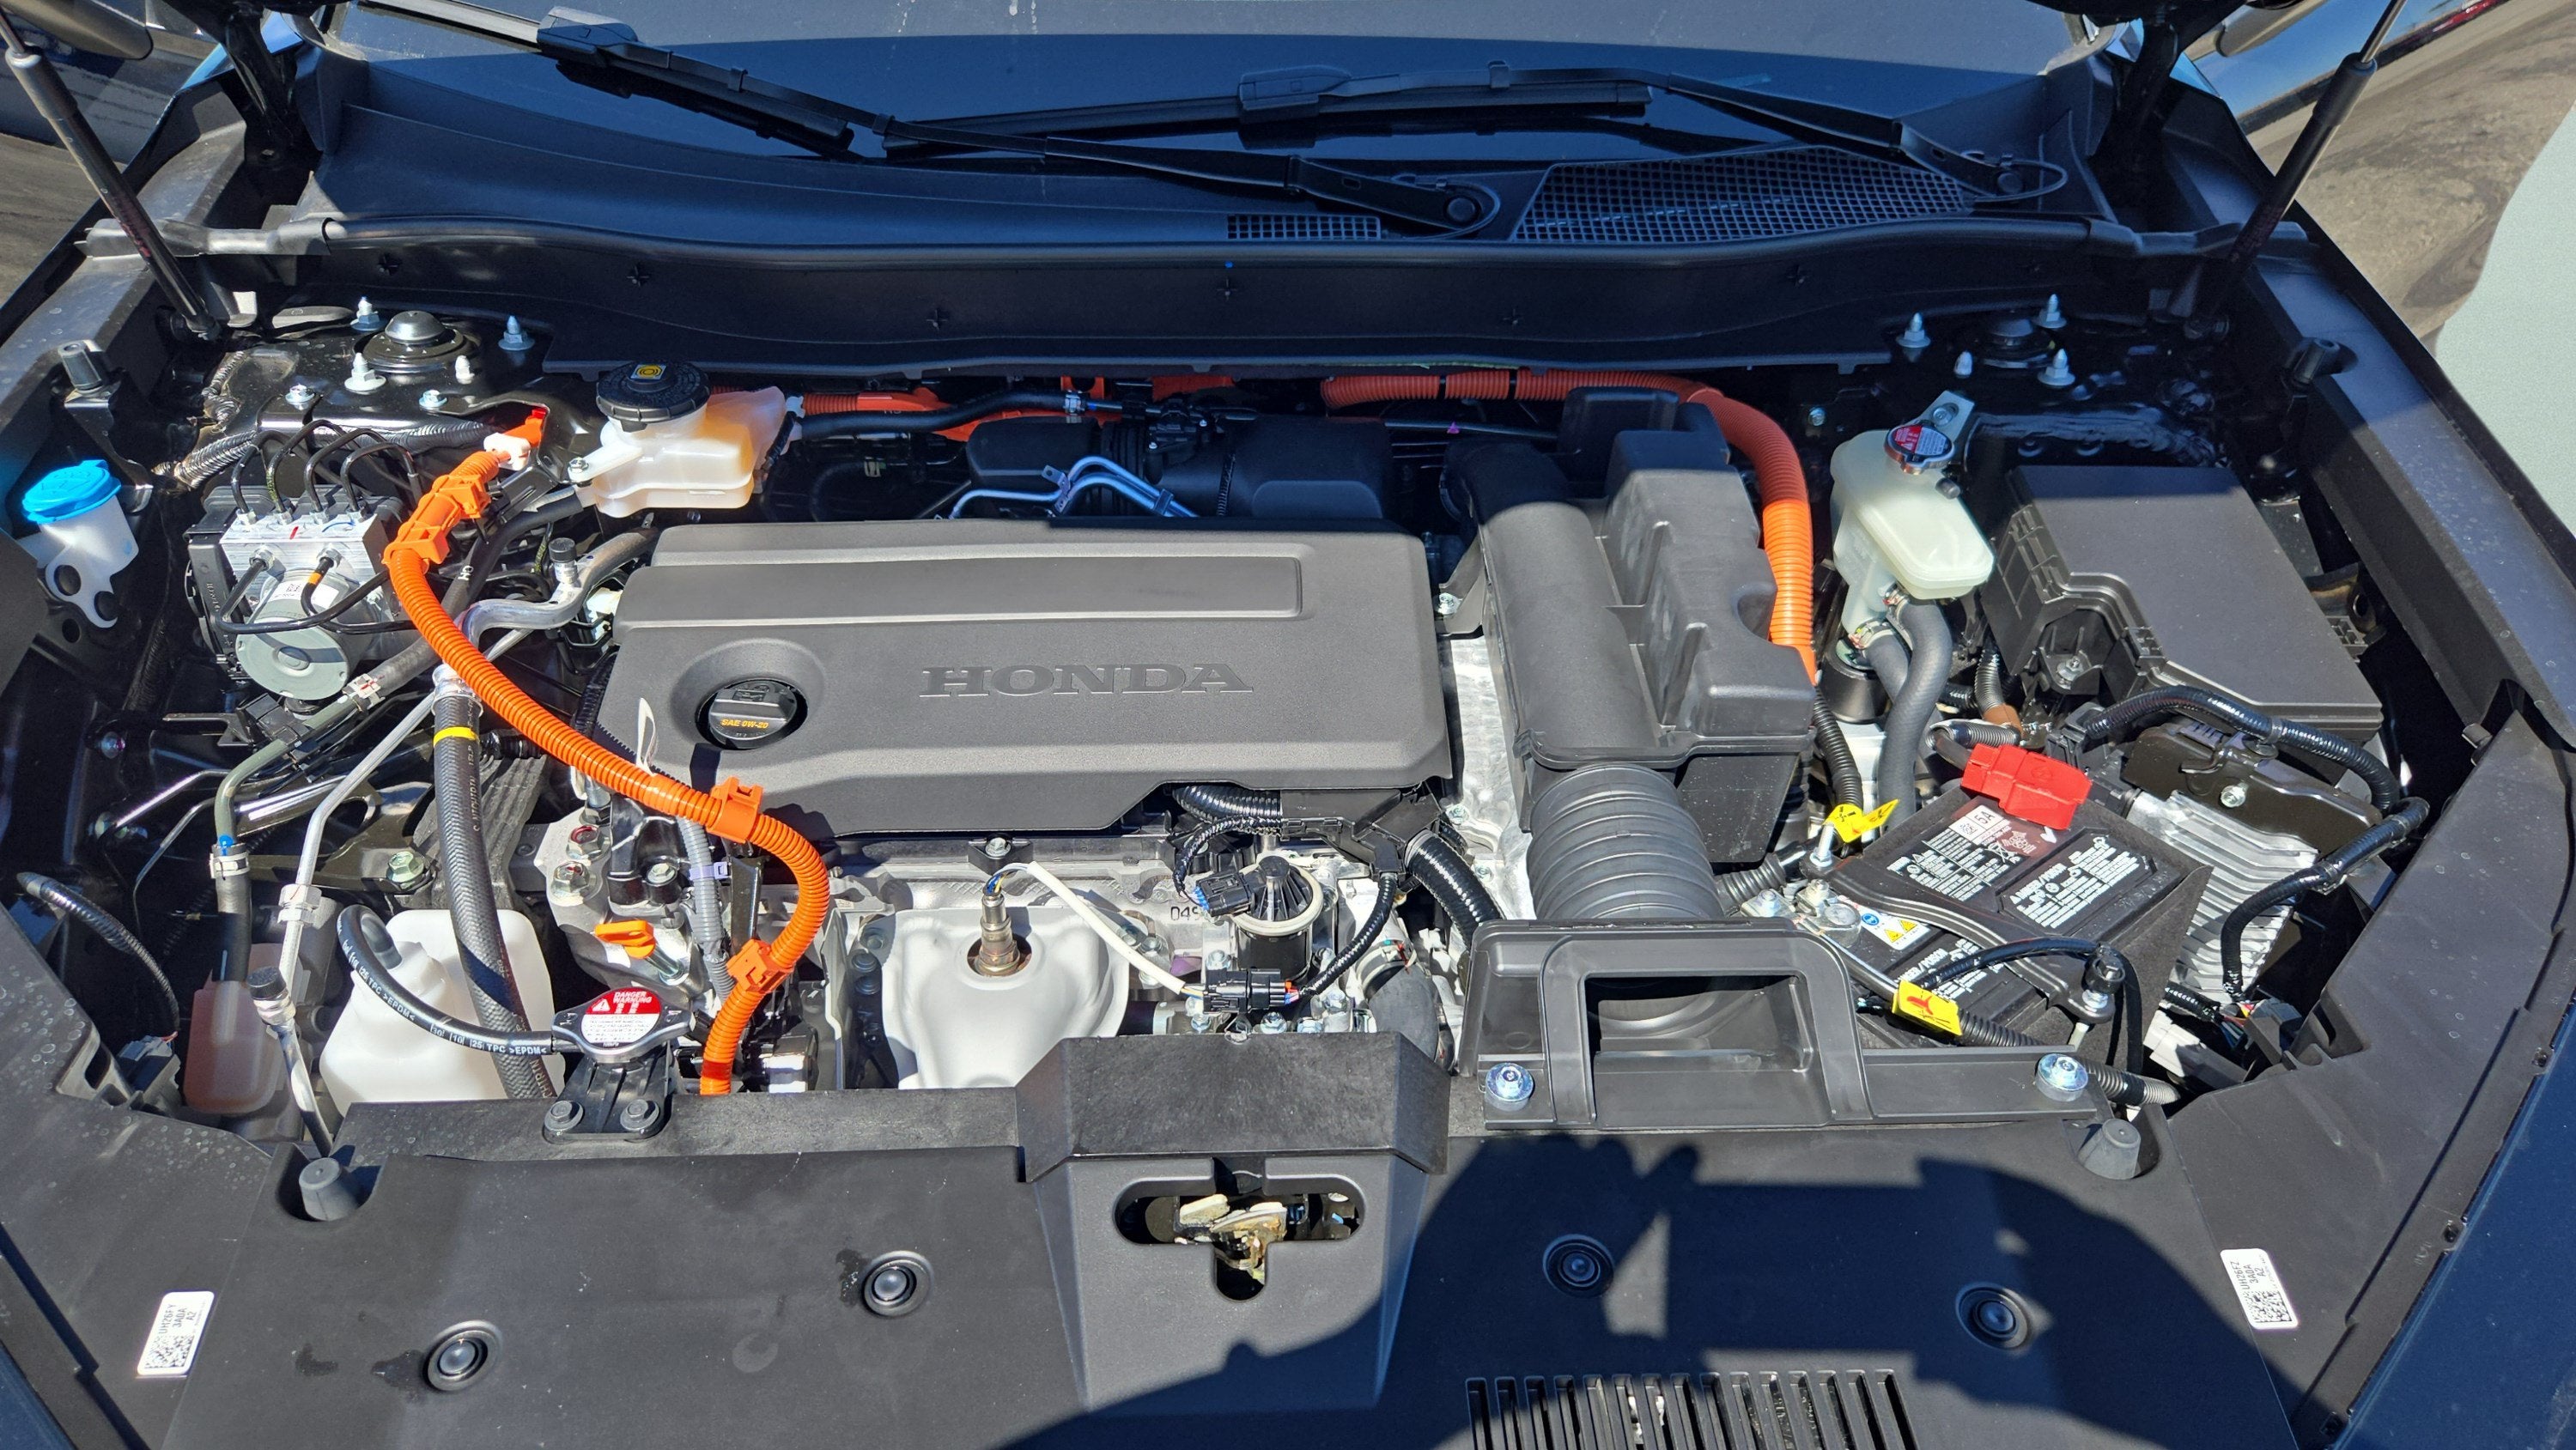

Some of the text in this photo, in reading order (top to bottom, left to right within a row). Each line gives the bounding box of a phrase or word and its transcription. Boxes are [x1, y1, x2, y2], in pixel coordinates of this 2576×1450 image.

[920, 663, 1254, 697] HONDA
[720, 719, 769, 729] SAE 0W-20
[1974, 810, 1996, 824] 5A
[368, 977, 381, 995] TPC
[487, 1043, 506, 1053] TPC
[2230, 1260, 2250, 1289] UH26FZ
[2255, 1267, 2266, 1277] A2
[158, 1303, 176, 1334] UH26FY
[186, 1311, 197, 1320] A2
